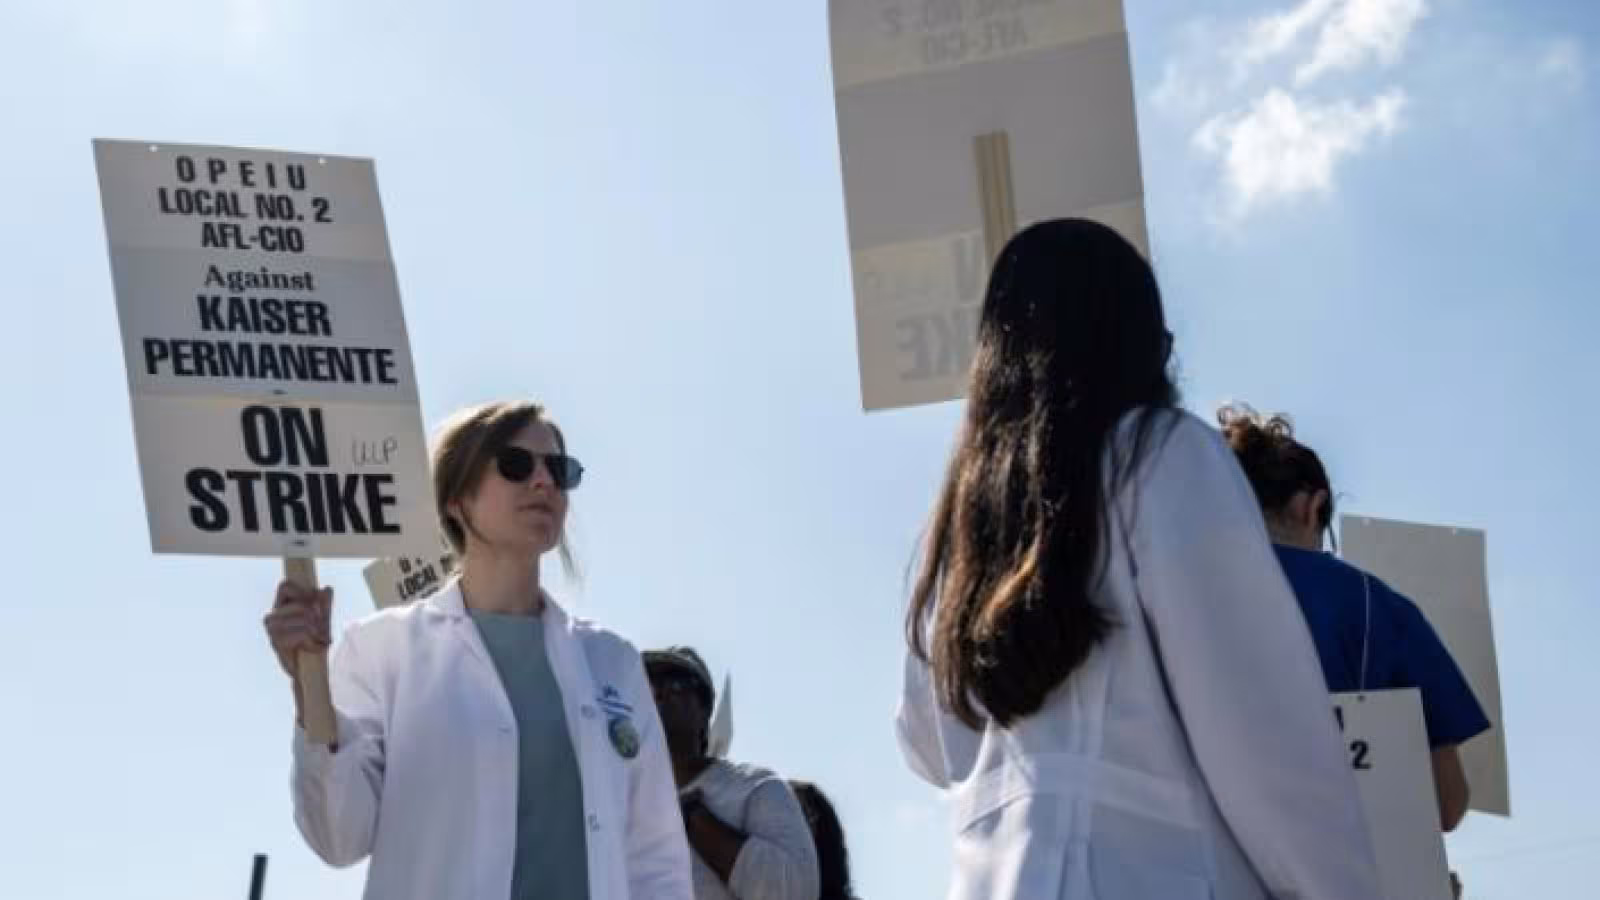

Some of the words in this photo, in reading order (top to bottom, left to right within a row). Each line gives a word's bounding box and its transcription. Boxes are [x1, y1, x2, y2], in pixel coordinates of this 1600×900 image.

[158, 187, 247, 219] LOCAL
[254, 193, 304, 223] NO.
[311, 197, 333, 222] 2
[201, 222, 304, 253] AFL-CIO
[203, 264, 314, 292] Against
[197, 295, 333, 337] KAISER
[143, 338, 398, 384] PERMANENTE
[240, 404, 330, 467] ON
[185, 467, 401, 534] STRIKE
[1350, 740, 1372, 769] 2
